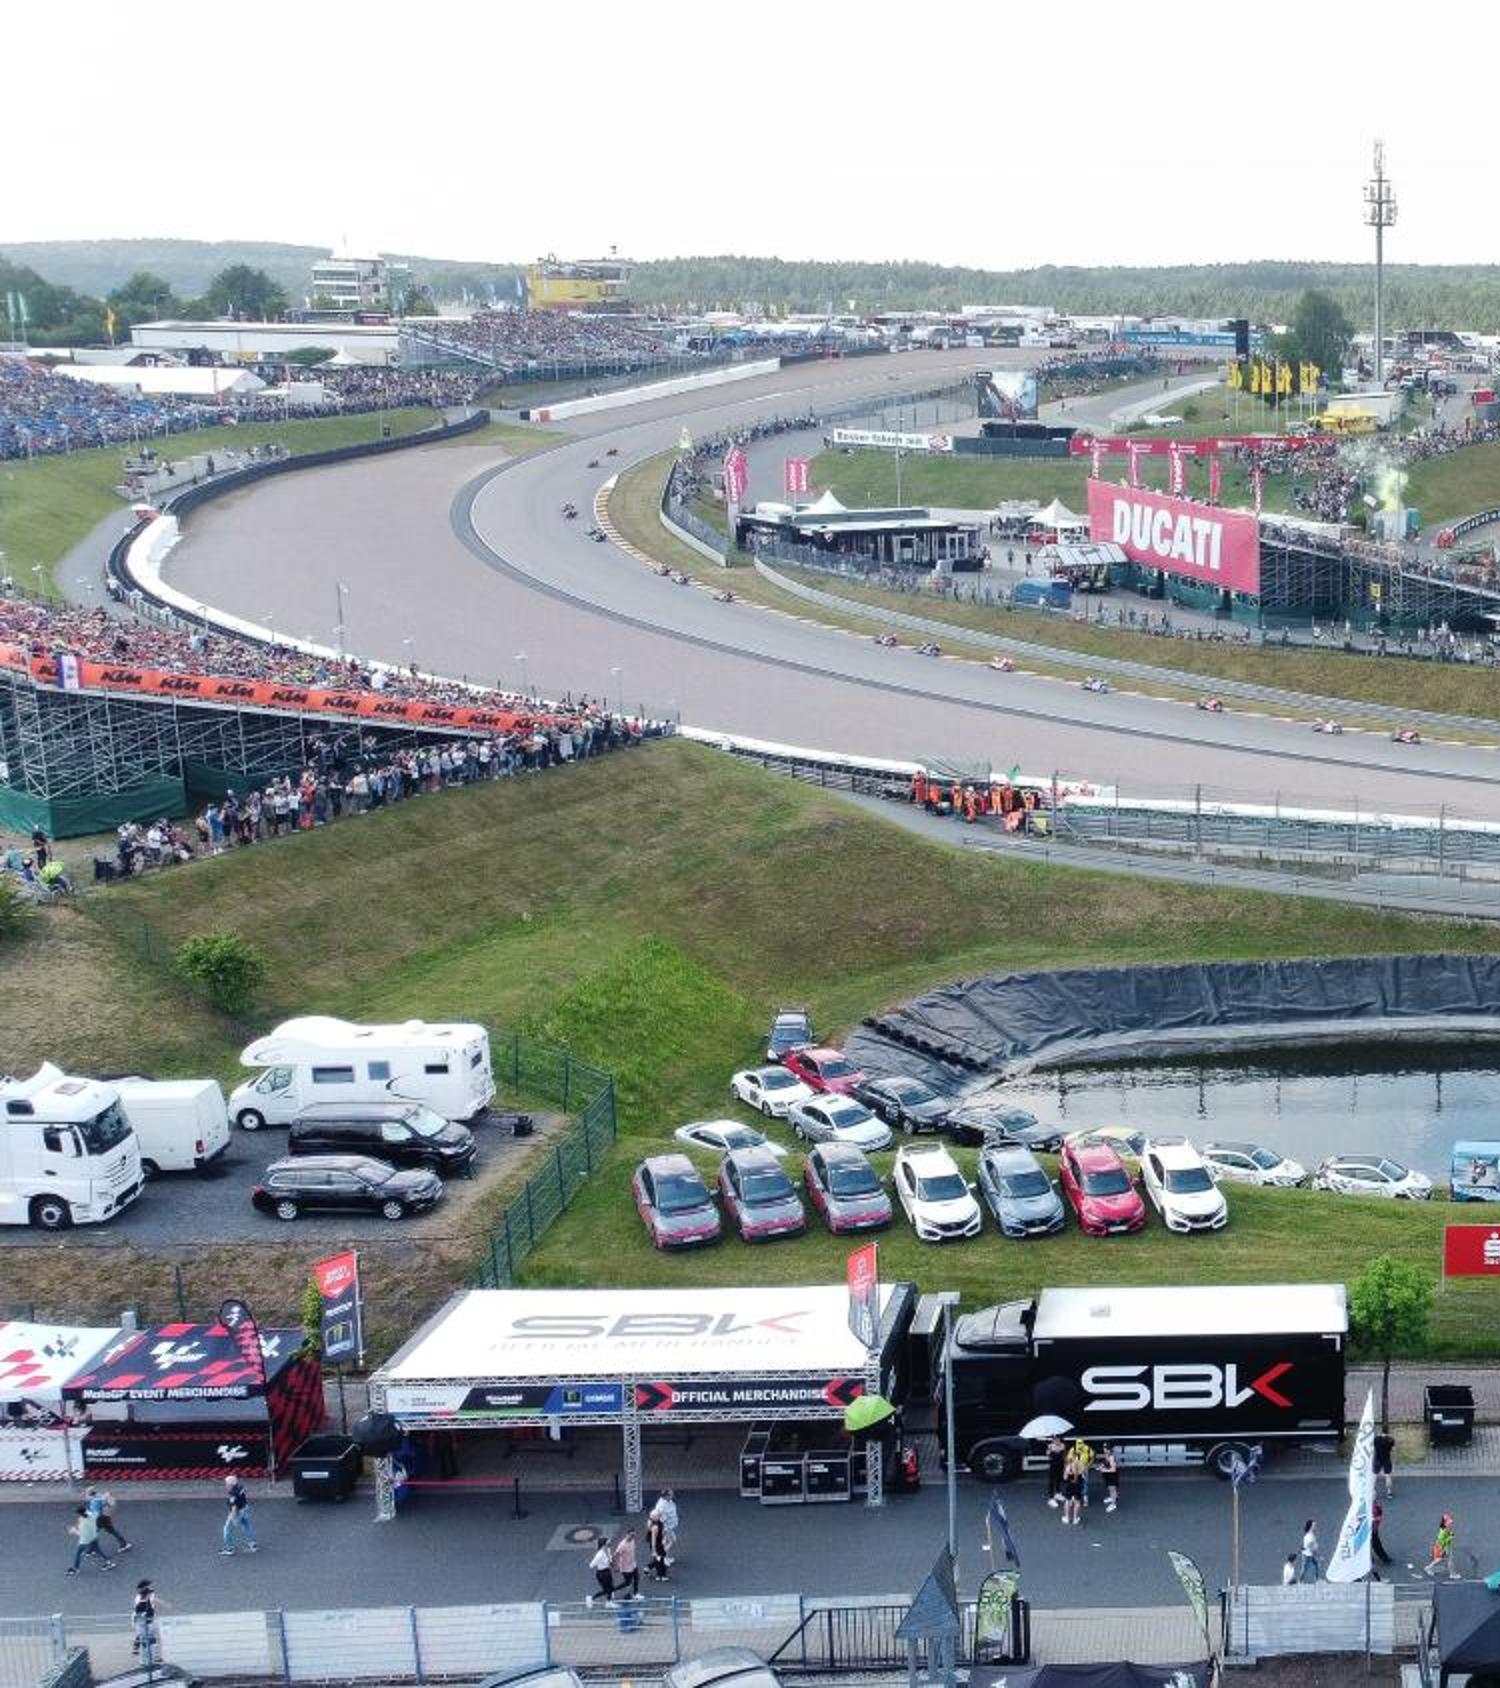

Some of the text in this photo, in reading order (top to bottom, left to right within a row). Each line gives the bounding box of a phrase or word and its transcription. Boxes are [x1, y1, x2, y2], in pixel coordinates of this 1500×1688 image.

[1112, 499, 1223, 571] DUCATI
[100, 670, 142, 685] KTM
[160, 676, 199, 692] KTM
[216, 683, 255, 698] KTM
[271, 690, 309, 704] KTM
[322, 695, 360, 710] KTM
[374, 703, 409, 716] KTM
[421, 708, 455, 720] KTM
[468, 714, 501, 726] KTM
[506, 1311, 812, 1339] SBK
[130, 1387, 166, 1399] EVENT
[167, 1384, 248, 1398] MERCHANDISE
[1081, 1363, 1294, 1411] SBK
[671, 1387, 829, 1403] OFFICIAL MERCHANDISE
